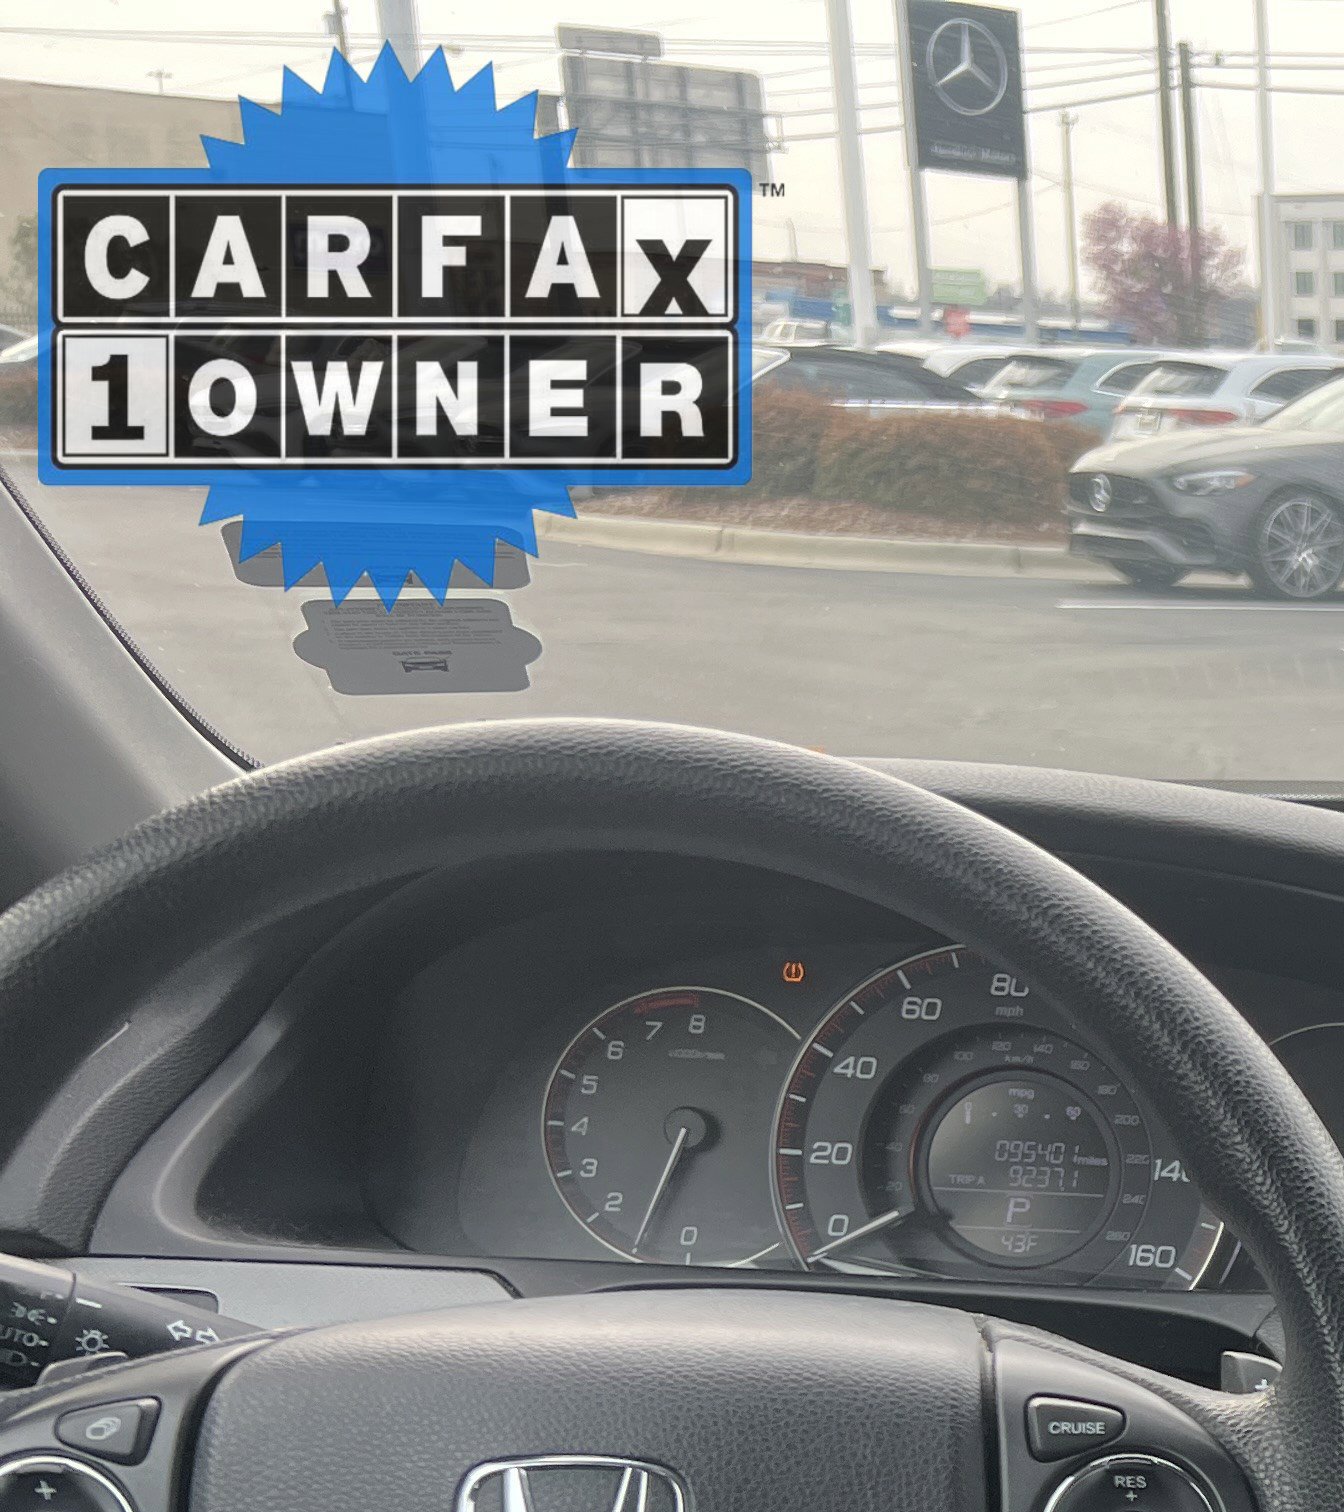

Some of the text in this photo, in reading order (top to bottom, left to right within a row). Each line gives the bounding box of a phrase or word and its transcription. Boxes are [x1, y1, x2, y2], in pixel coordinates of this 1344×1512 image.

[901, 997, 942, 1020] 60
[995, 1004, 1024, 1017] mph
[645, 1021, 663, 1040] 7
[688, 1014, 706, 1034] 8
[606, 1040, 625, 1060] 6
[833, 1056, 877, 1079] 40
[580, 1075, 599, 1094] 5
[1008, 1088, 1035, 1100] mpg
[571, 1117, 589, 1136] 4
[810, 1142, 853, 1165] 20
[579, 1158, 598, 1178] 3
[604, 1192, 623, 1212] 2
[1006, 1198, 1030, 1223] P
[828, 1214, 849, 1236] 0
[680, 1226, 698, 1245] 0
[1128, 1244, 1176, 1268] 160
[0, 1325, 40, 1347] UTO
[1049, 1421, 1106, 1435] CRUISE
[1114, 1475, 1147, 1488] RES
